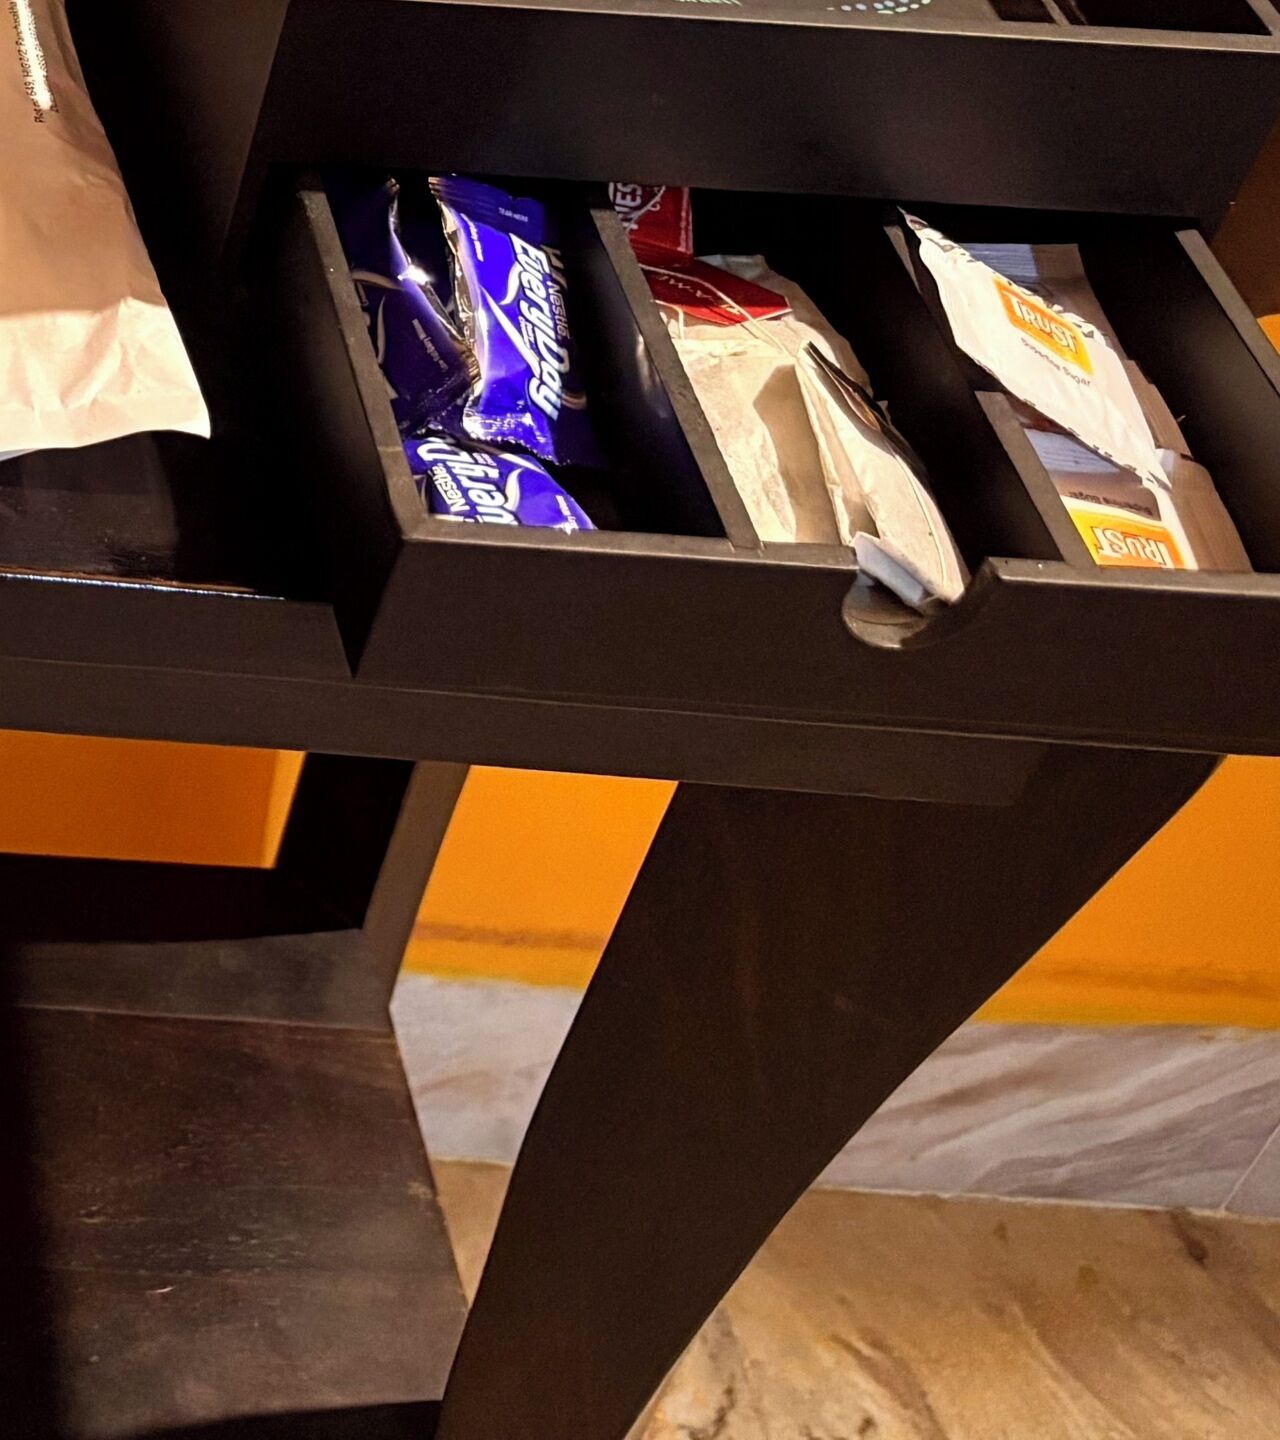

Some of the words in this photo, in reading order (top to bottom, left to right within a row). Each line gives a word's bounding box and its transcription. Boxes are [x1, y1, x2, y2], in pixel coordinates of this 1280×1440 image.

[1003, 289, 1079, 355] TRUST
[1062, 366, 1092, 388] Sugar
[1090, 525, 1176, 569] TRUST
